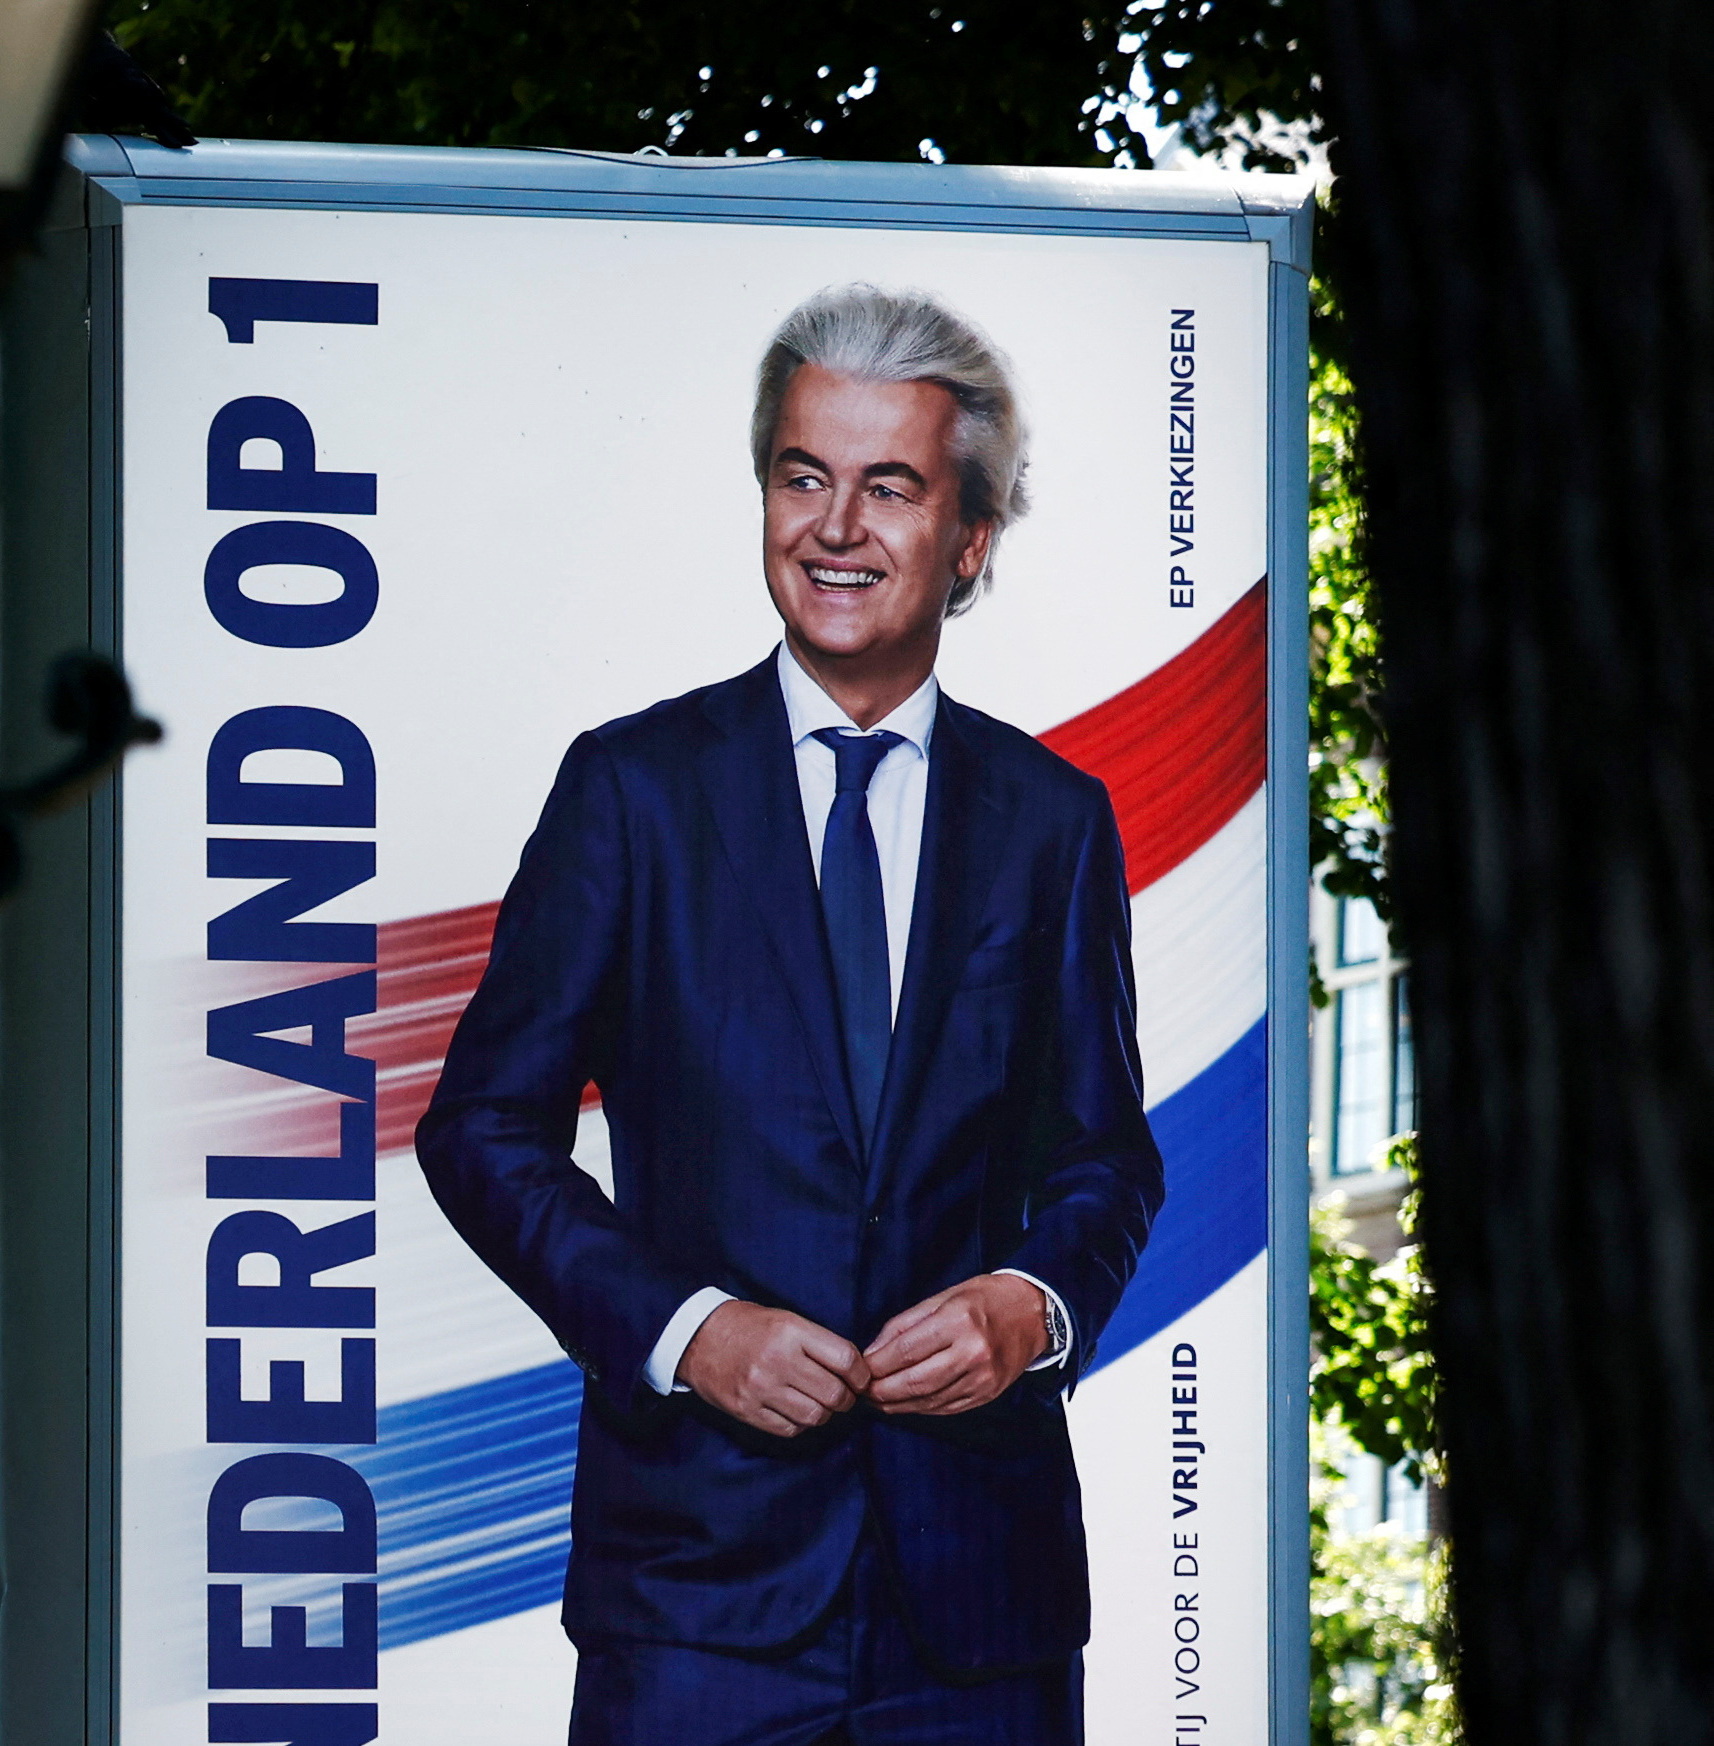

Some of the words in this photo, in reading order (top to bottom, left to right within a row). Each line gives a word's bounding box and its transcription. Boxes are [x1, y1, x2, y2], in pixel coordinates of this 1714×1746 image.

[208, 276, 380, 345] 1
[1169, 308, 1195, 557] VERKIEZINGEN
[204, 395, 380, 649] OP
[1169, 565, 1194, 608] EP
[1172, 1342, 1206, 1520] VRIJHEID
[1173, 1532, 1199, 1577] DE
[1174, 1592, 1199, 1699] VOOR
